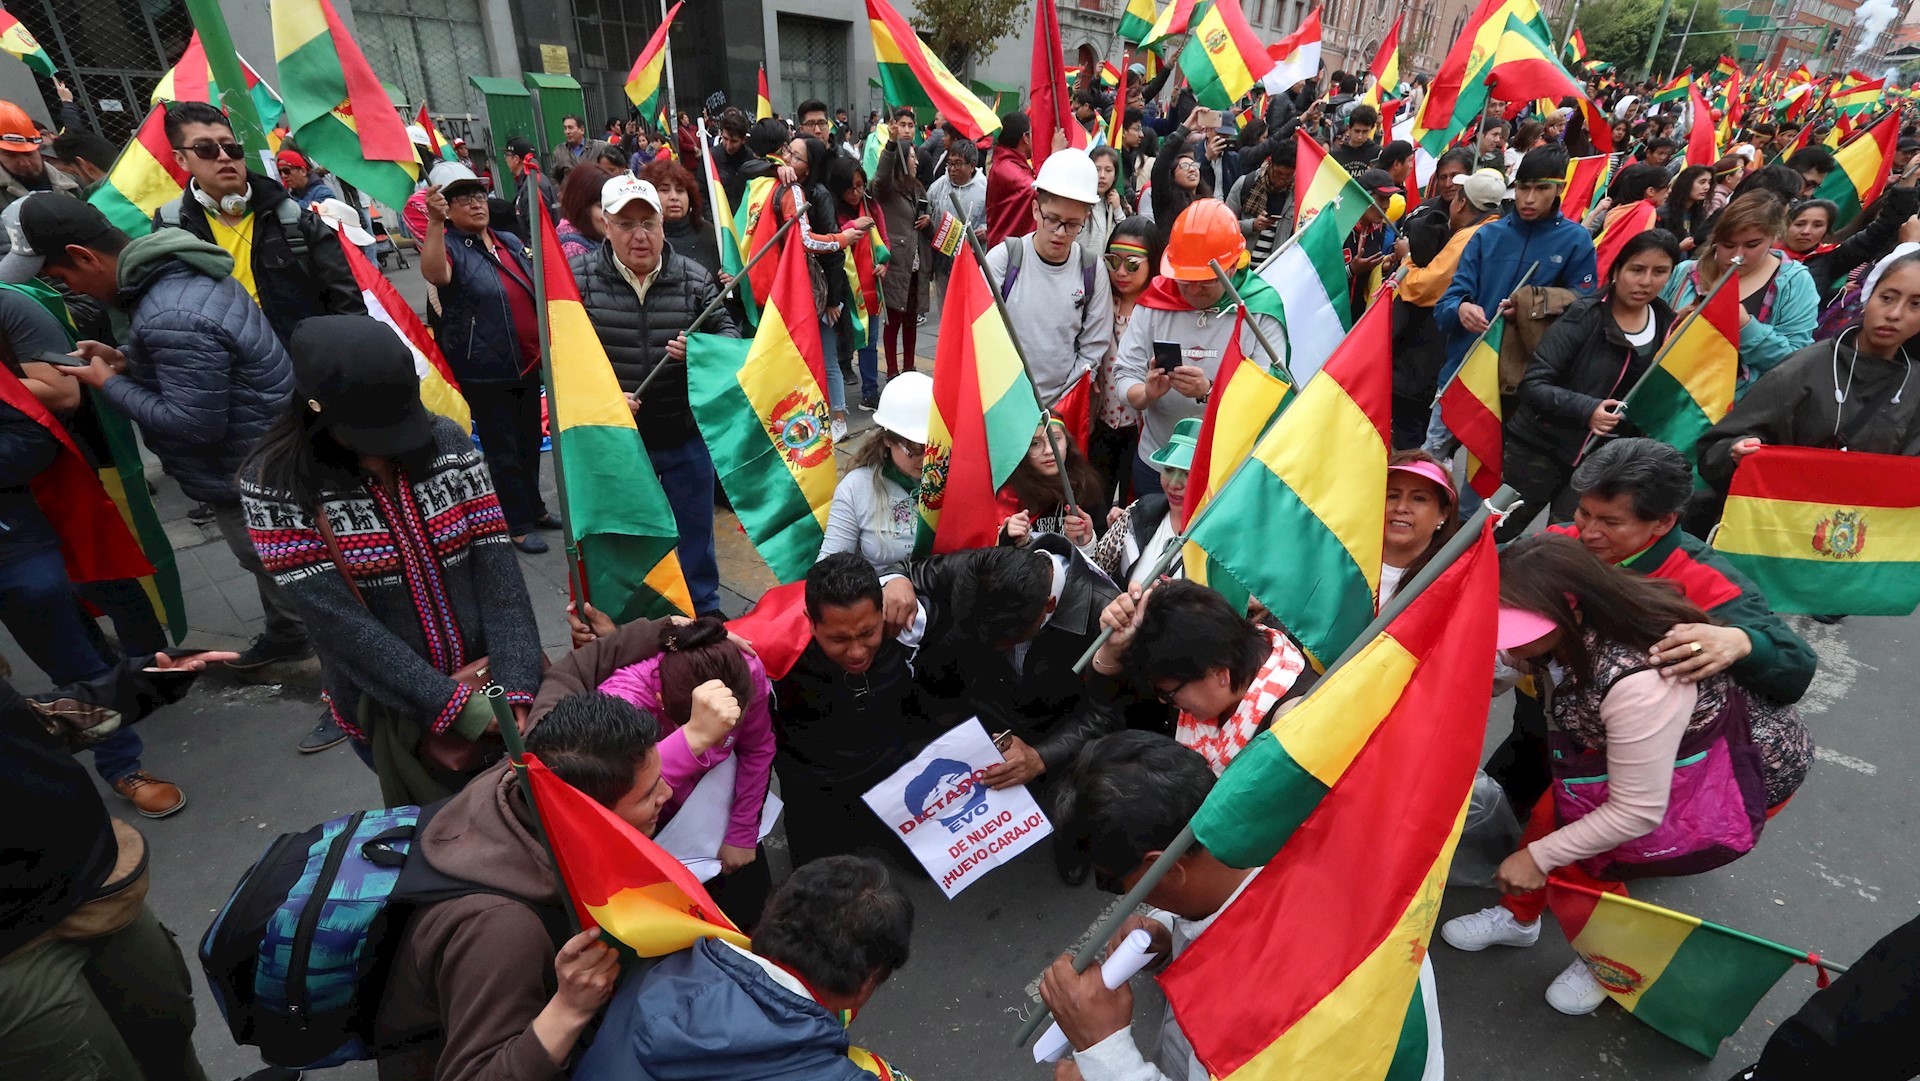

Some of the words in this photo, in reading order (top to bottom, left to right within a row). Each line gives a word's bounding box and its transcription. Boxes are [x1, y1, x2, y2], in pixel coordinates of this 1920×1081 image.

[898, 762, 1002, 835] DICTADO
[948, 803, 989, 834] EVO
[942, 848, 989, 890] ¡HUEVO
[988, 811, 1044, 854] CARAJO!
[948, 839, 969, 859] DE
[969, 810, 1013, 846] NUEVO
